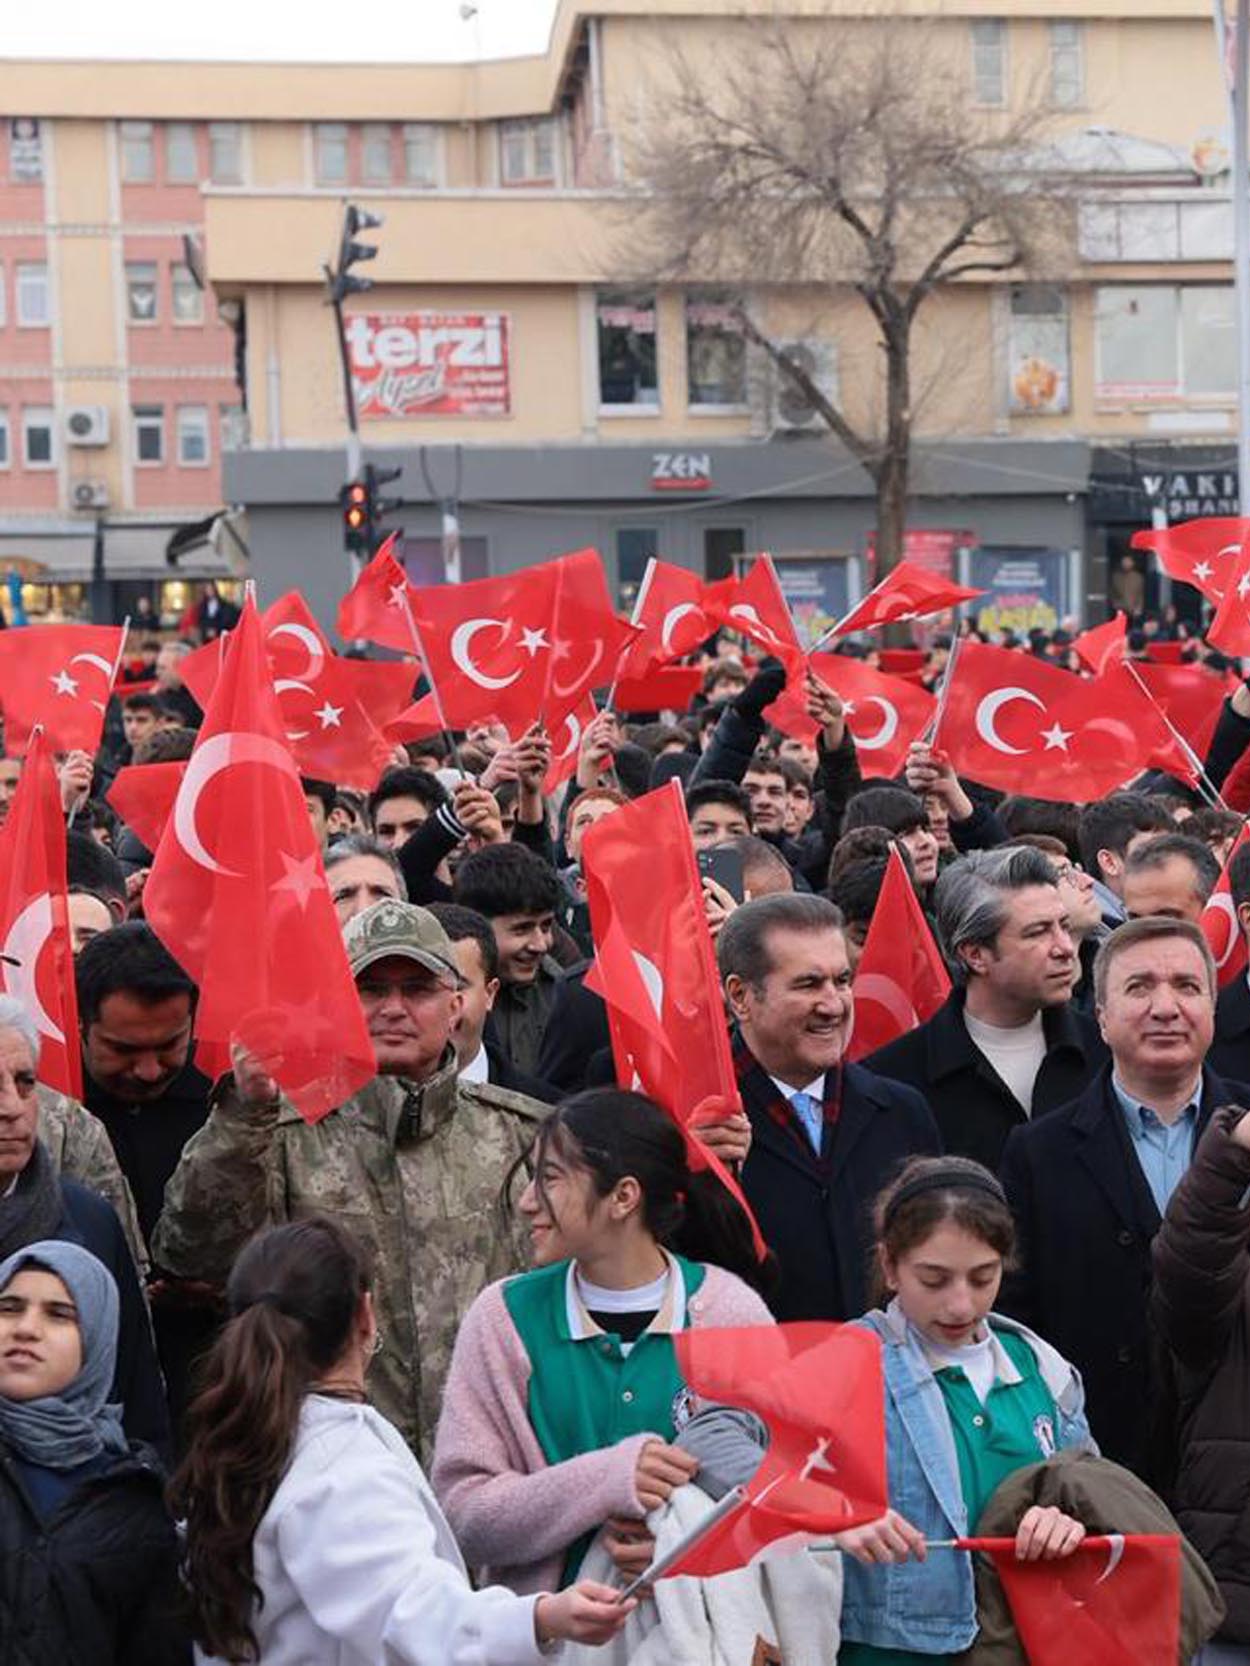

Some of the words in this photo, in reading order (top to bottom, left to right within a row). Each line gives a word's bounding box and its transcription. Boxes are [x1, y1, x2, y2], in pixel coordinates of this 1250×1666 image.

[346, 314, 502, 368] terzi
[653, 453, 710, 477] ZEN
[1142, 475, 1235, 496] VAKI
